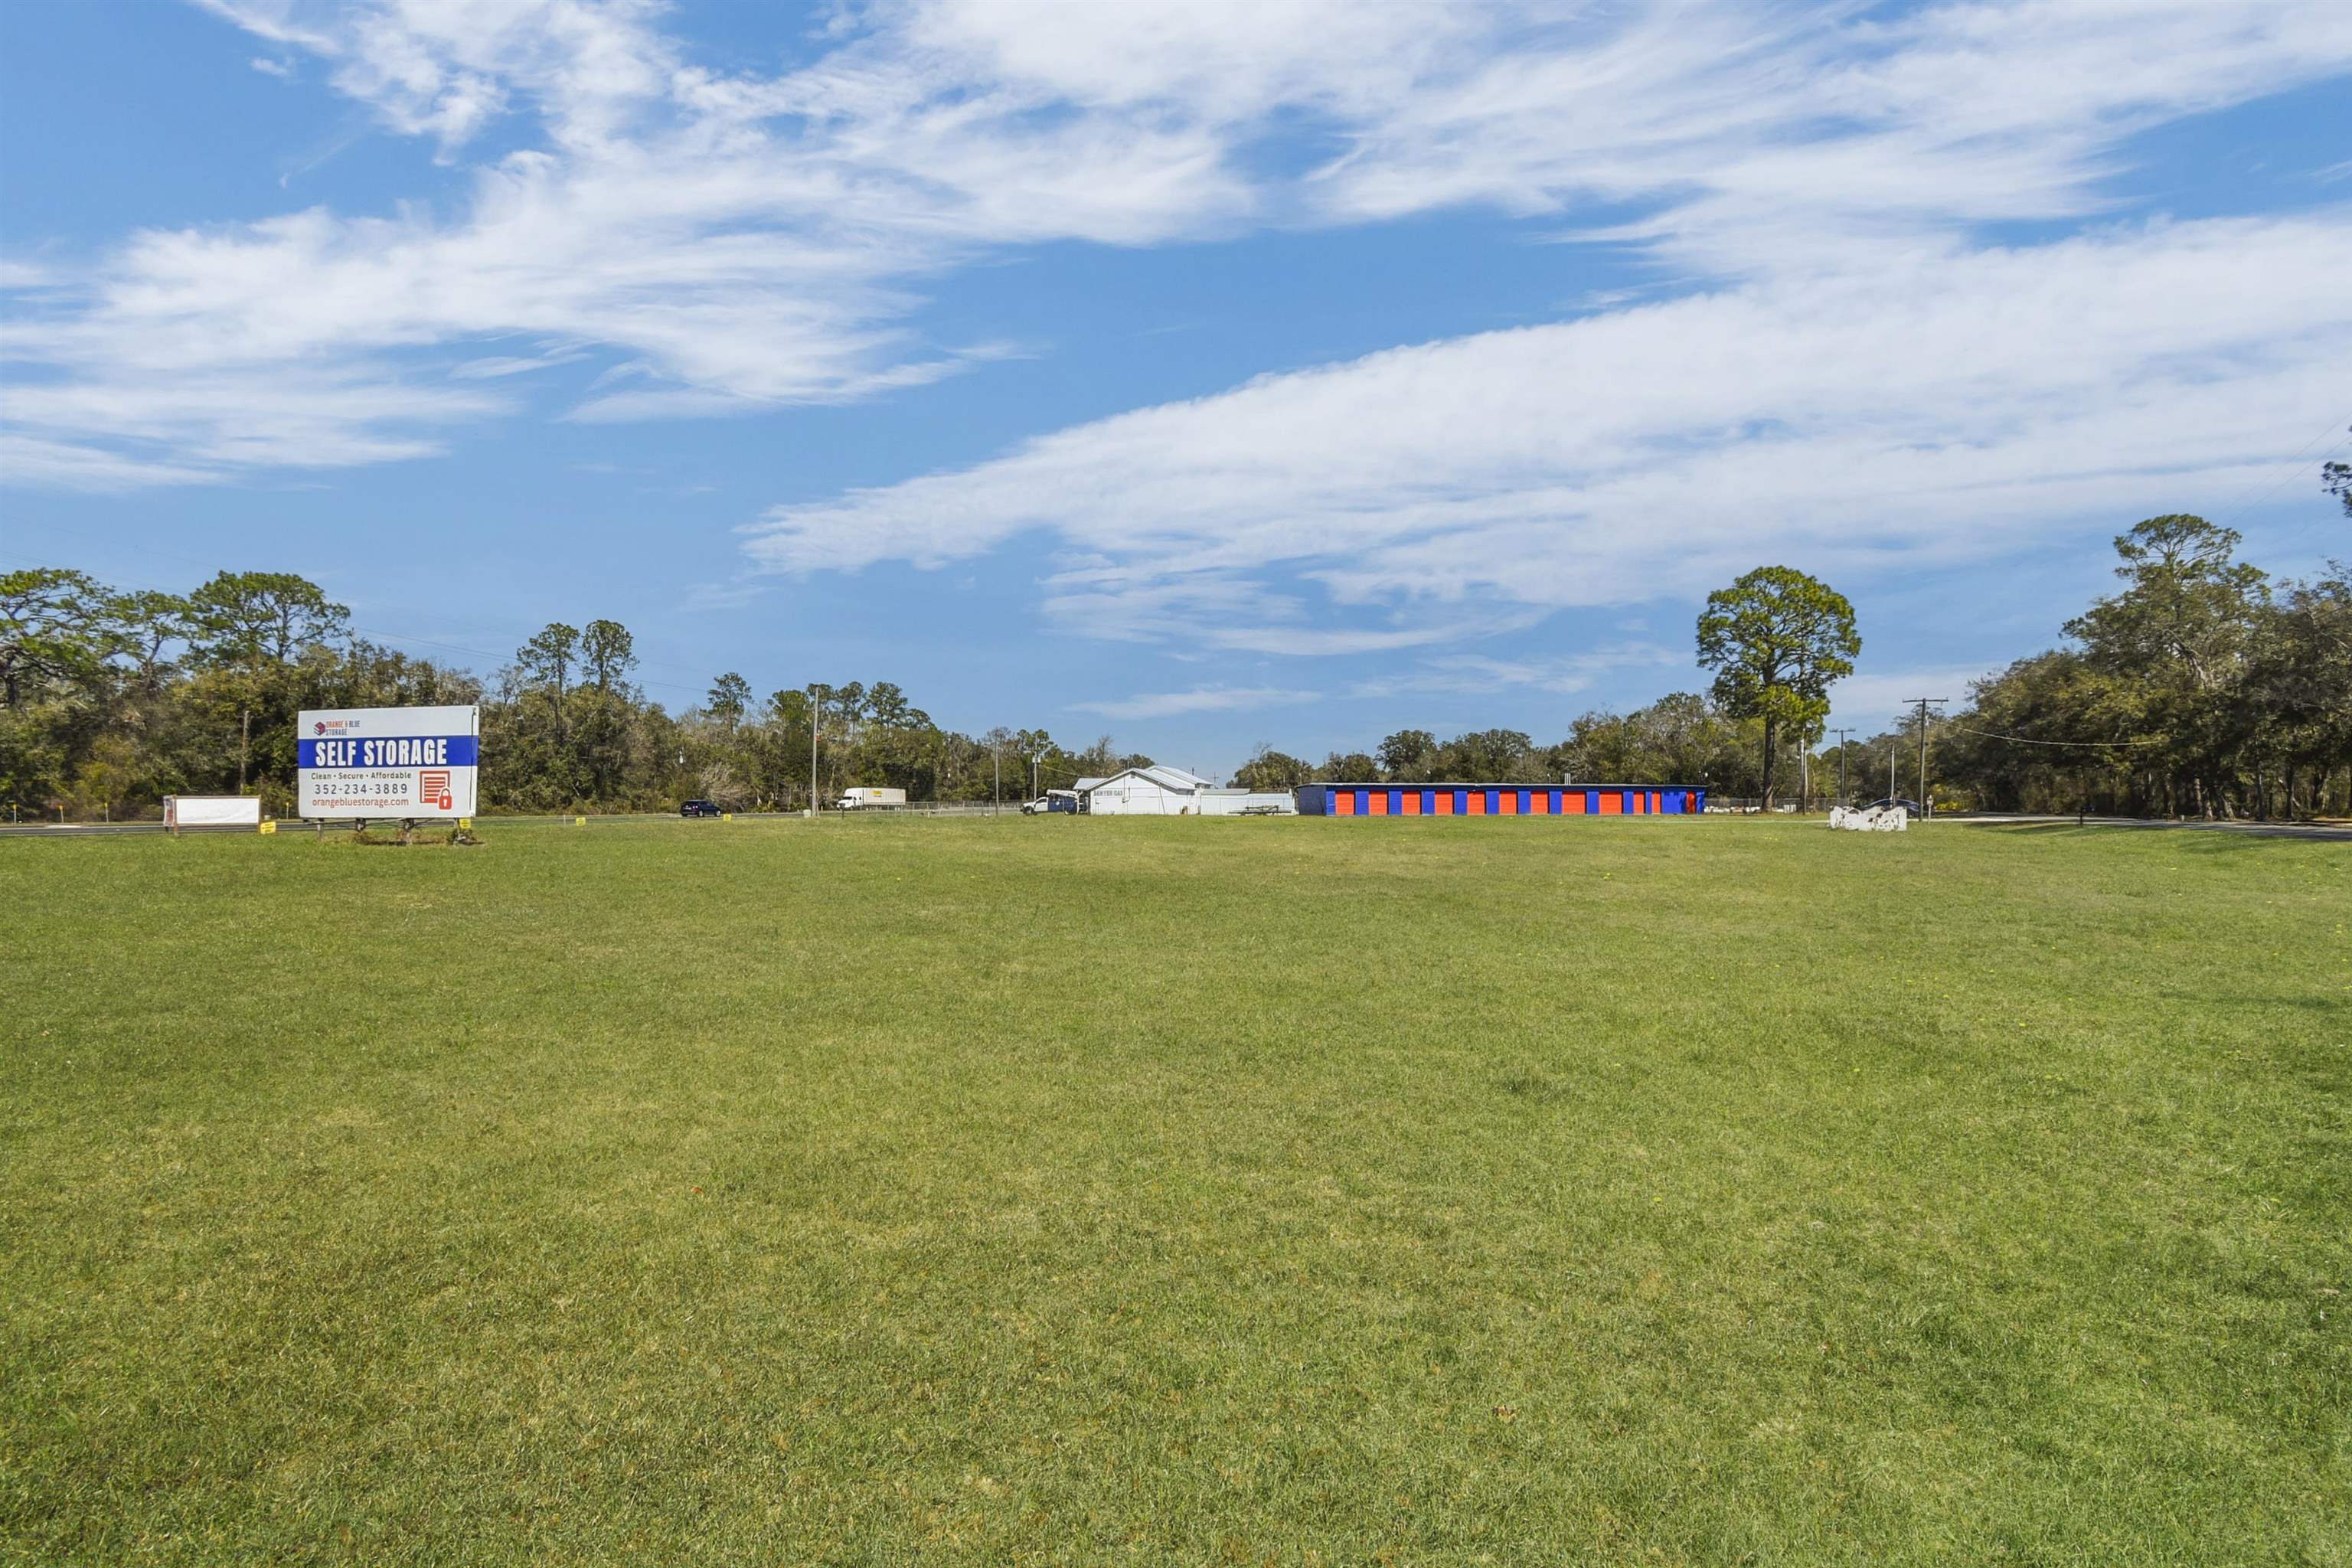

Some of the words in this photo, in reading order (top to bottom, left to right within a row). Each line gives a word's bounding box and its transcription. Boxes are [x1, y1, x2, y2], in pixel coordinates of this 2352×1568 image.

[315, 741, 356, 766] SELF
[364, 739, 447, 766] STORAGE
[315, 783, 407, 795] 352-234-3889
[312, 798, 410, 808] orangebluestorage.com
